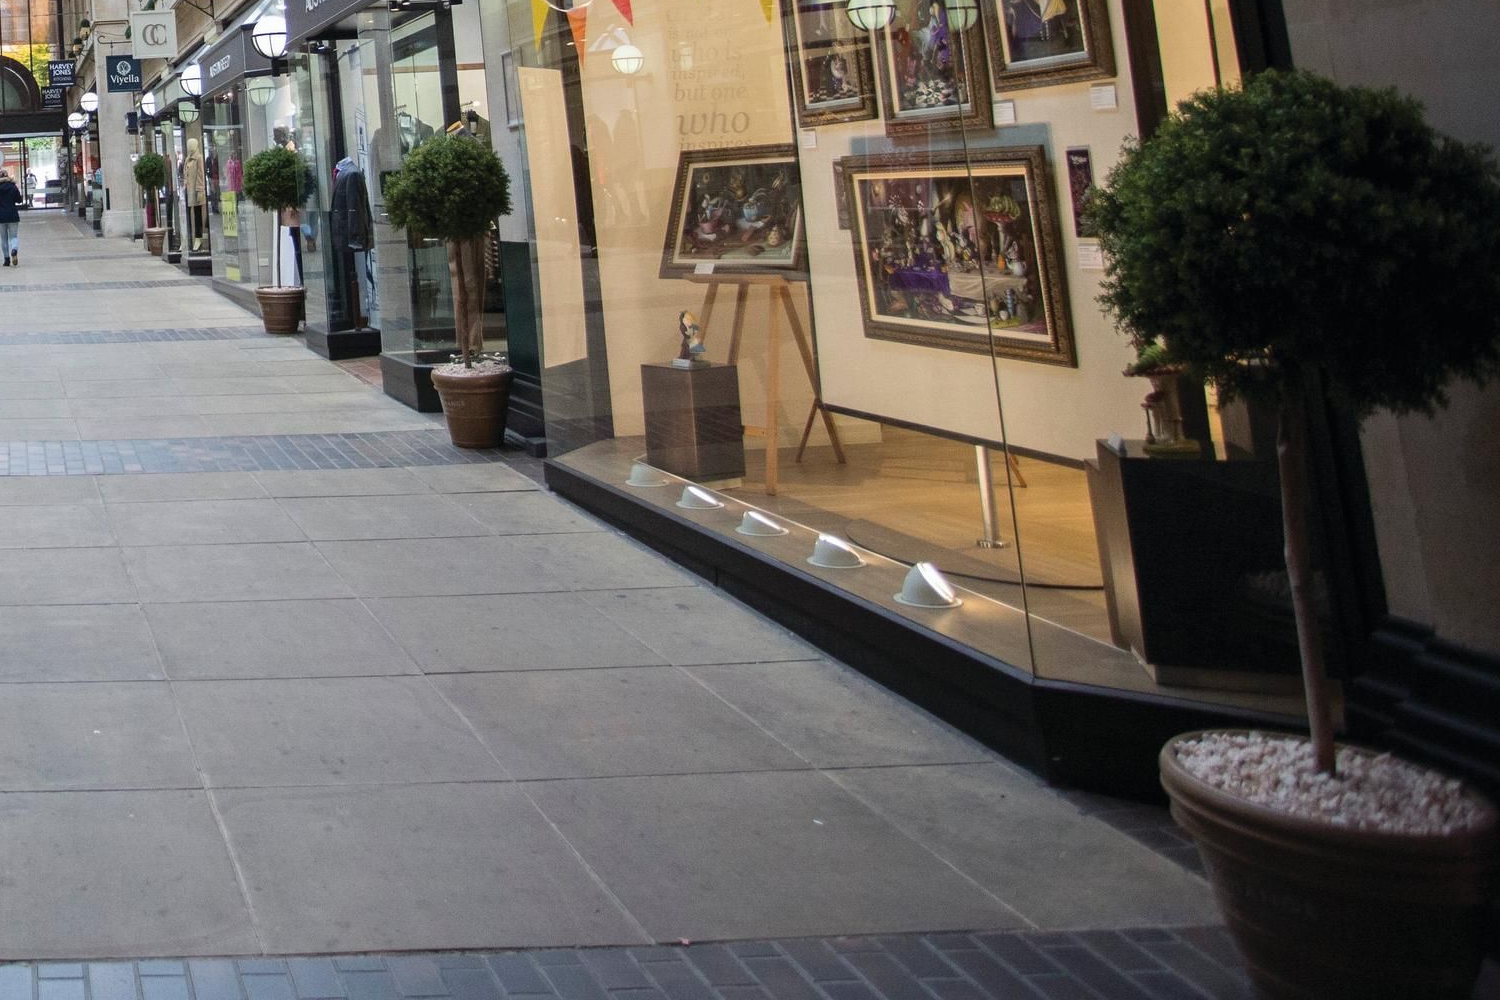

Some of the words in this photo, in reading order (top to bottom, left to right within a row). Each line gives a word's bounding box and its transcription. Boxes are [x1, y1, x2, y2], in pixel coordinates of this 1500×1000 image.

[49, 62, 74, 71] HARVEY
[53, 69, 72, 77] JONES
[110, 74, 140, 86] Viyella
[674, 83, 706, 102] but
[711, 84, 748, 101] one
[676, 103, 750, 136] who
